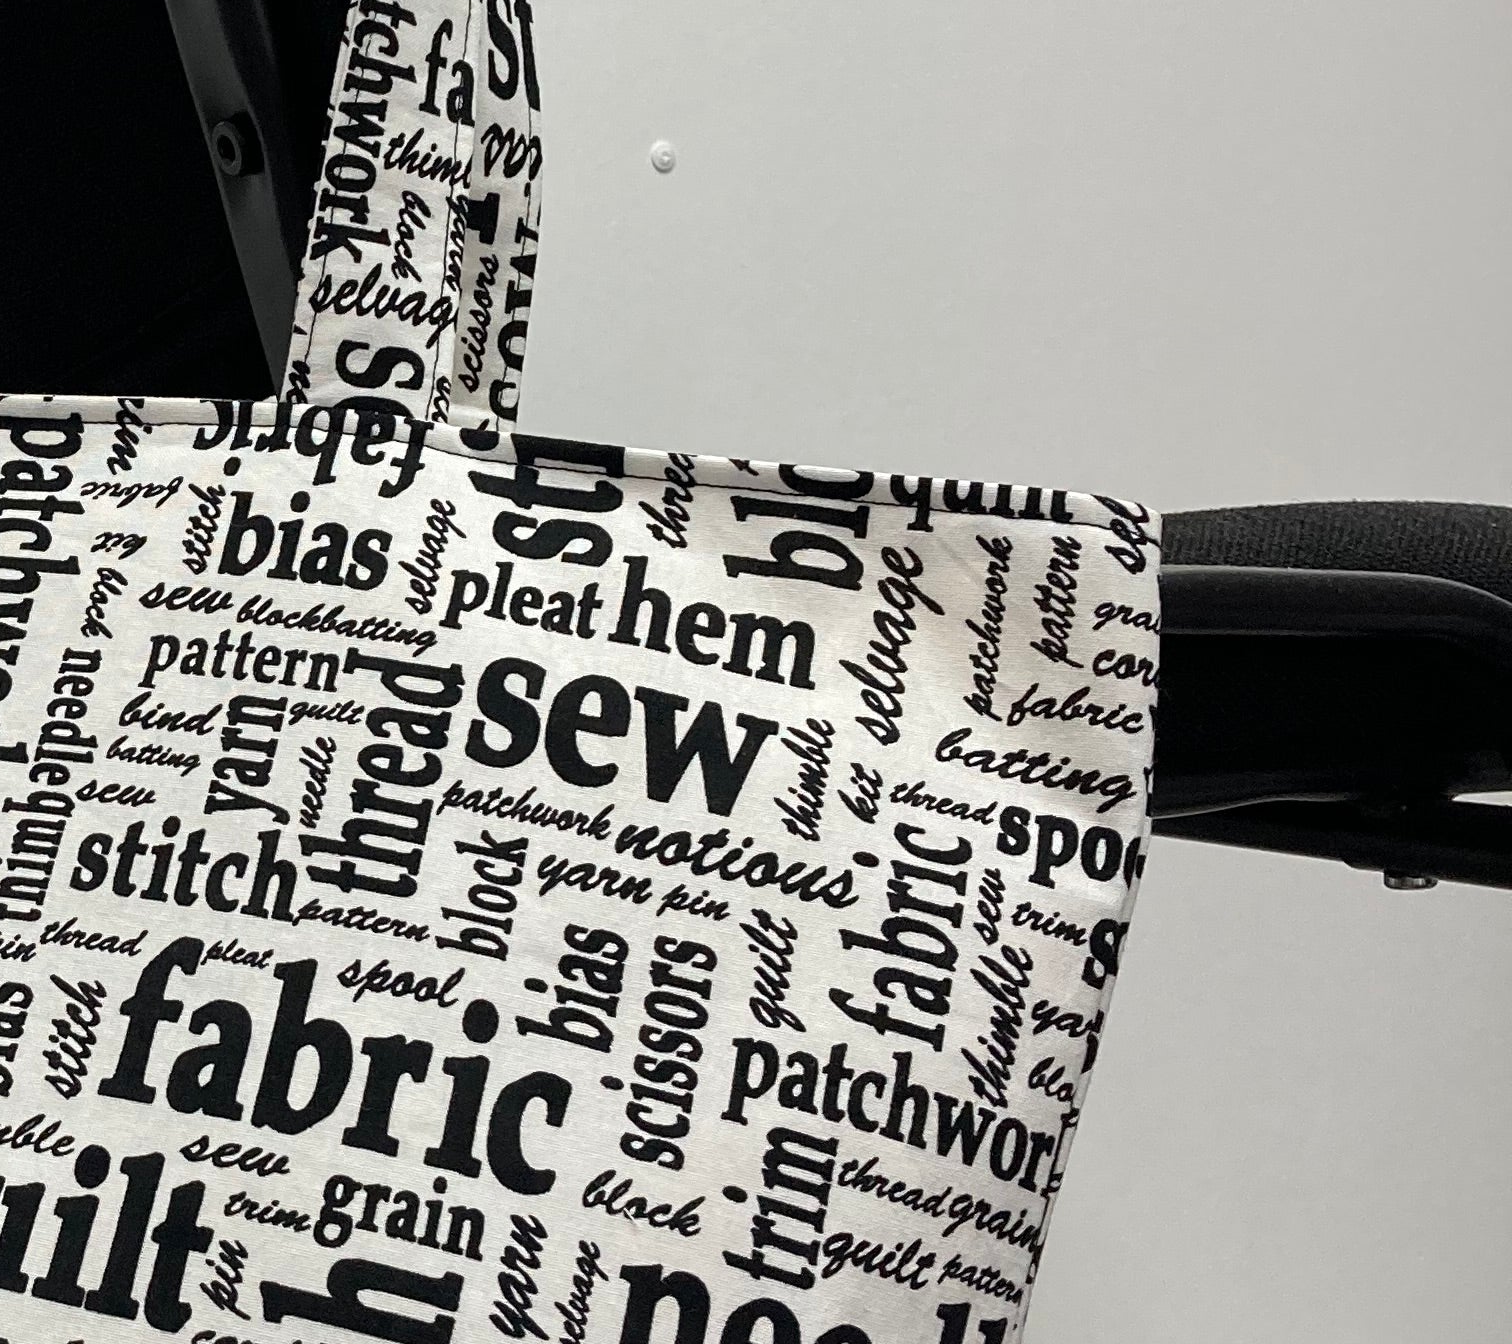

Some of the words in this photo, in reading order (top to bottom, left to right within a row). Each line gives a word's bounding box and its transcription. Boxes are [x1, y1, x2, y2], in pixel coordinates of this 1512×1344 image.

[218, 491, 393, 591] bias
[439, 562, 604, 639] pleat
[1030, 536, 1084, 668] pattern
[607, 556, 815, 690] hem
[839, 547, 945, 746] selvage
[294, 647, 465, 898] thread
[465, 657, 779, 817] sew
[935, 728, 1137, 814] batting
[69, 816, 303, 926] stitch
[294, 899, 430, 942] pattern
[537, 855, 652, 904] yarn
[515, 924, 629, 1053] bias
[829, 822, 972, 1052] fabric
[97, 930, 572, 1195] fabric
[600, 935, 717, 1171] scissors
[179, 1135, 290, 1177] sew
[313, 1175, 485, 1262] grain
[582, 1170, 705, 1237] block
[722, 1127, 839, 1290] trim
[837, 1157, 952, 1217] thread
[944, 1196, 1044, 1255] grain
[489, 1215, 550, 1341] yarn
